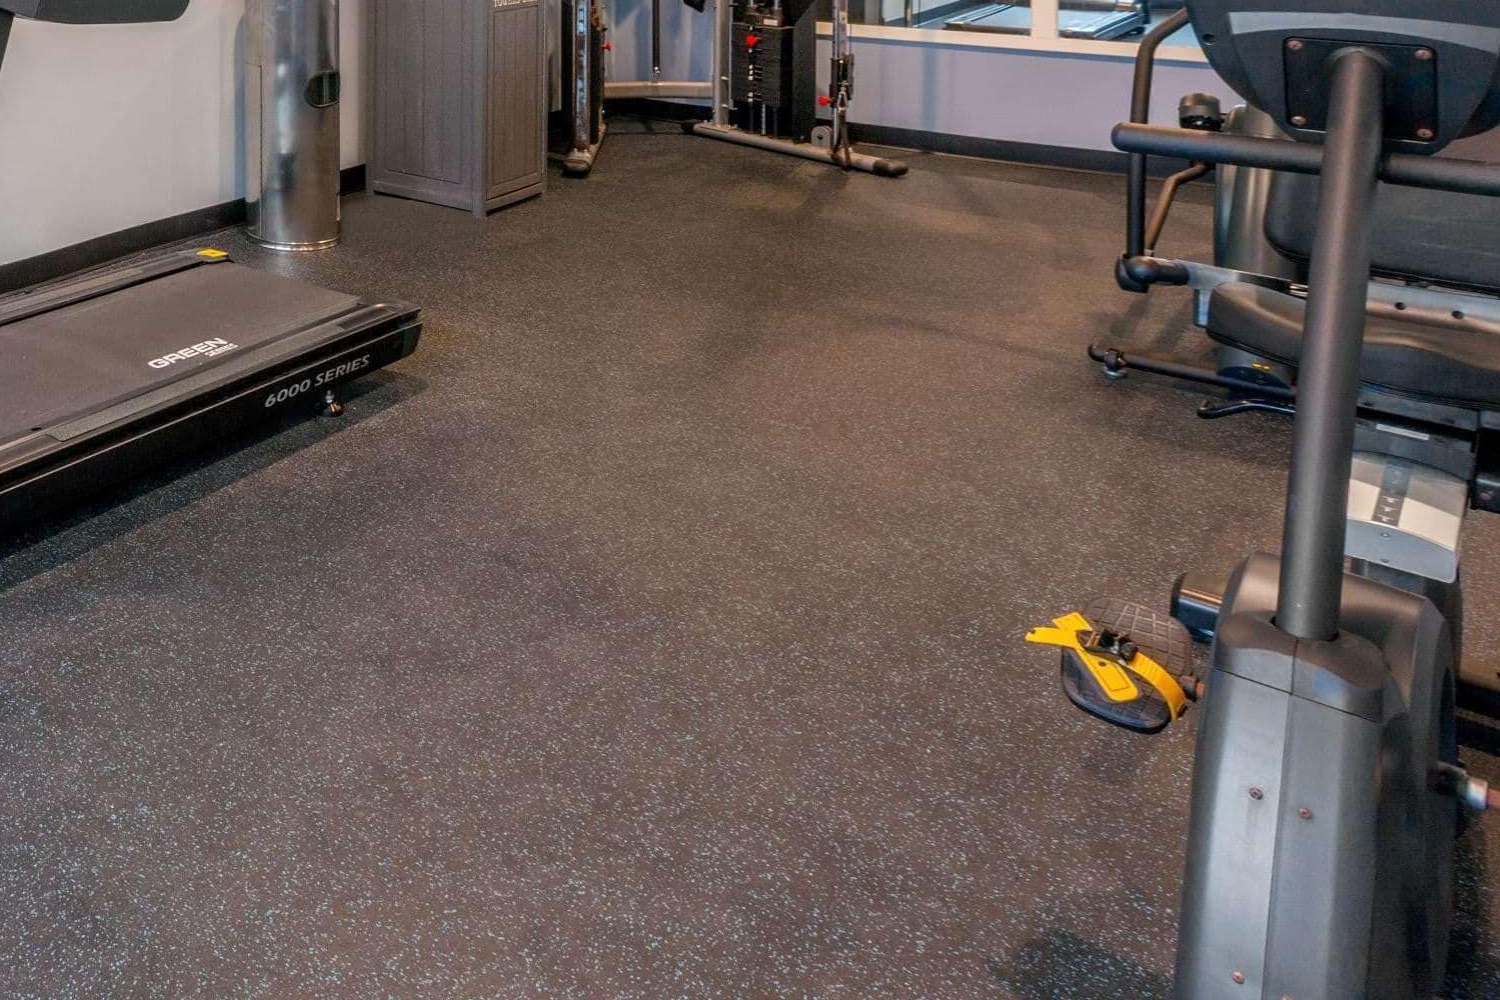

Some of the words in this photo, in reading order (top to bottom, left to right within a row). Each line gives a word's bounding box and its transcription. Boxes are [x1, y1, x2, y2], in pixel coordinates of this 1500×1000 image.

[147, 337, 229, 369] GREEN
[264, 378, 311, 408] 6000
[314, 353, 371, 388] SERIES
